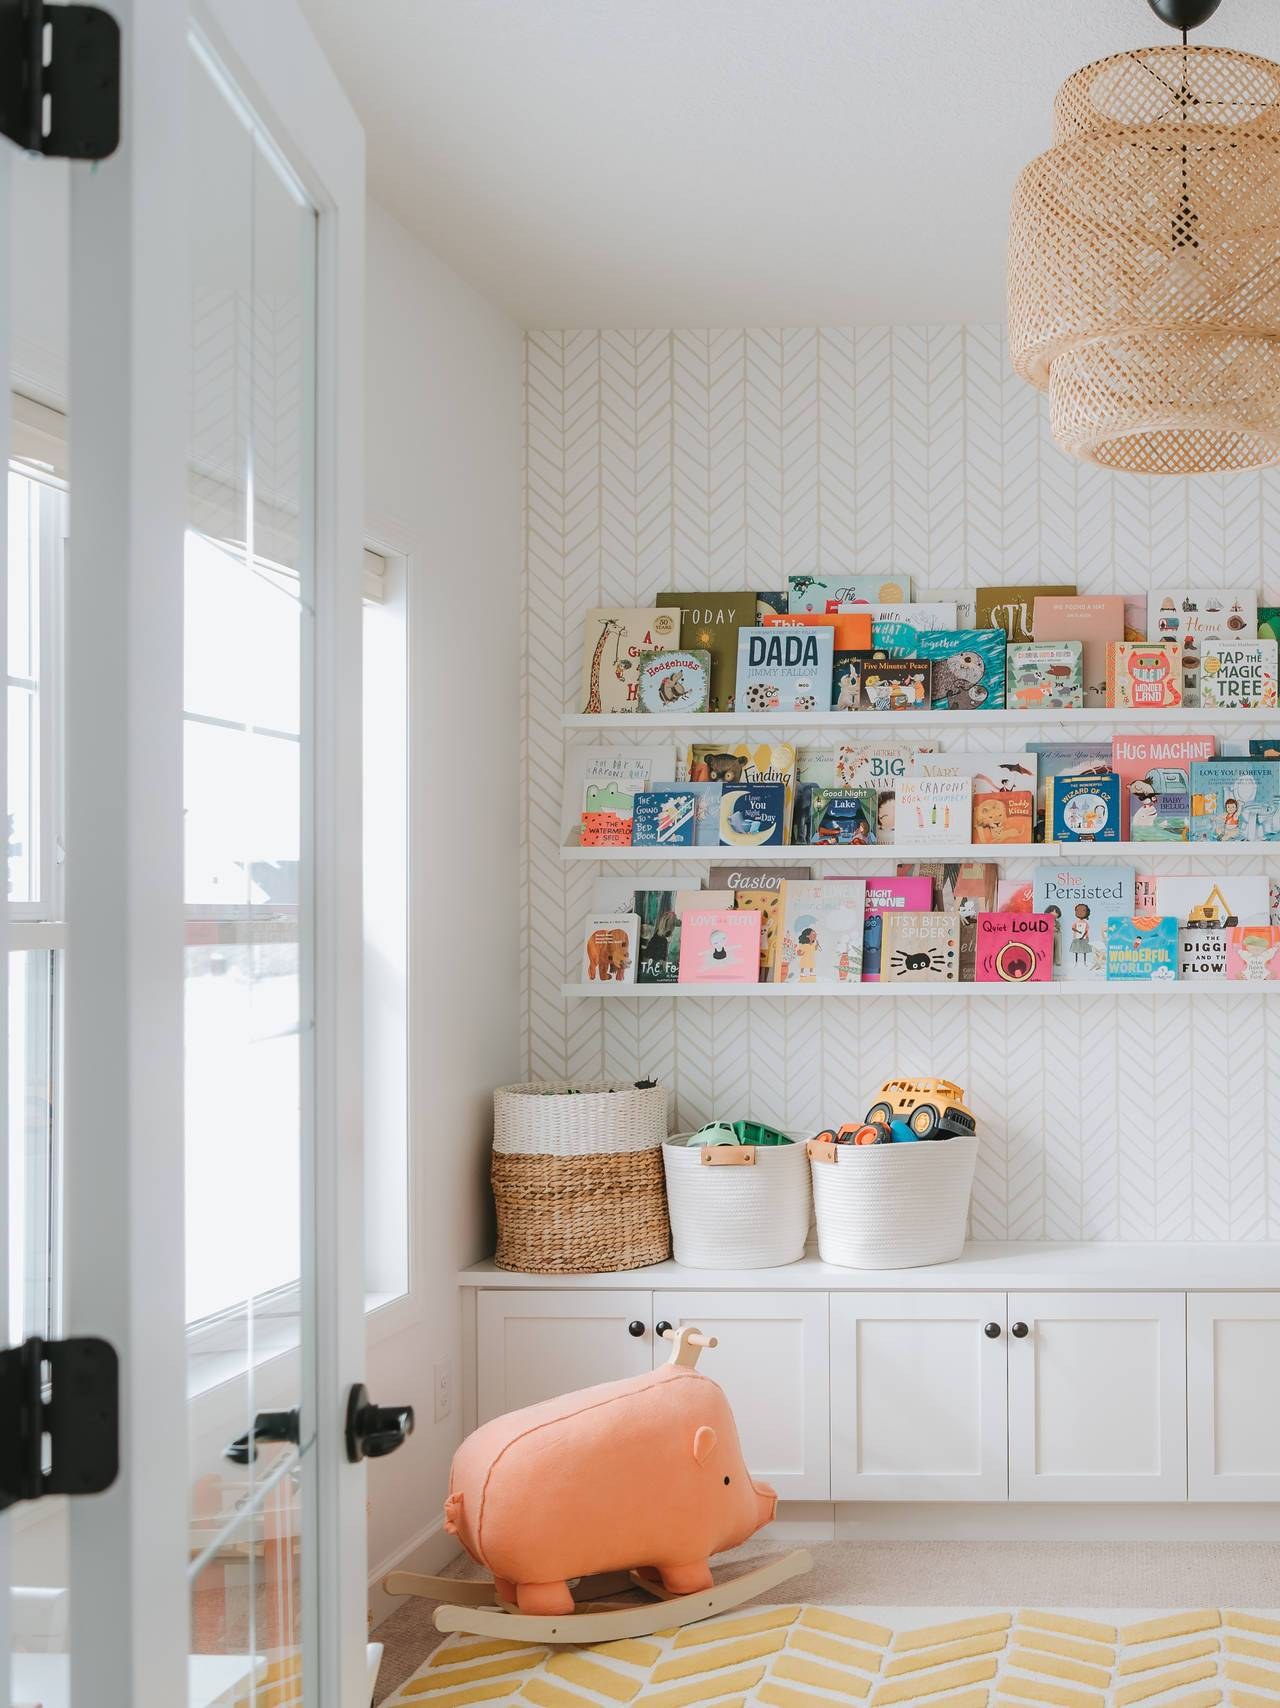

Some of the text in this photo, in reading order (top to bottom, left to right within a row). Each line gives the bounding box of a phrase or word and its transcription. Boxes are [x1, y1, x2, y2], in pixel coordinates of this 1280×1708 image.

[835, 587, 856, 601] The
[680, 609, 736, 625] TODAY
[1184, 616, 1222, 633] Home
[643, 630, 653, 645] A
[920, 637, 960, 649] Together
[748, 635, 819, 667] DADA
[1217, 651, 1262, 664] TAP THE
[646, 659, 701, 677] Hedgehugs
[863, 662, 928, 670] Five Minutes' Peace
[1217, 665, 1262, 678] MAGIC
[748, 668, 818, 678] JIMMY FALLON
[1217, 680, 1262, 696] TREE
[1116, 741, 1212, 760] HUG MACHINE
[870, 757, 906, 777] BIG
[1199, 769, 1273, 777] LOVE YOU FOREVER
[744, 765, 792, 787] Finding
[822, 789, 868, 798] Good Night
[1062, 787, 1089, 803] WIZARD
[1101, 792, 1112, 802] OZ
[750, 800, 767, 809] You
[834, 800, 856, 809] Lake
[1008, 799, 1030, 808] Daddy
[745, 809, 776, 824] Night Day
[1057, 871, 1082, 886] She
[1045, 882, 1123, 899] Persisted
[890, 916, 957, 928] ITSY BITSY
[982, 920, 1049, 933] Quiet LOUD
[902, 928, 945, 938] SPIDER
[1109, 947, 1171, 963] WONDERFUL
[1109, 963, 1153, 974] WORLD
[1182, 963, 1227, 973] FLOW
